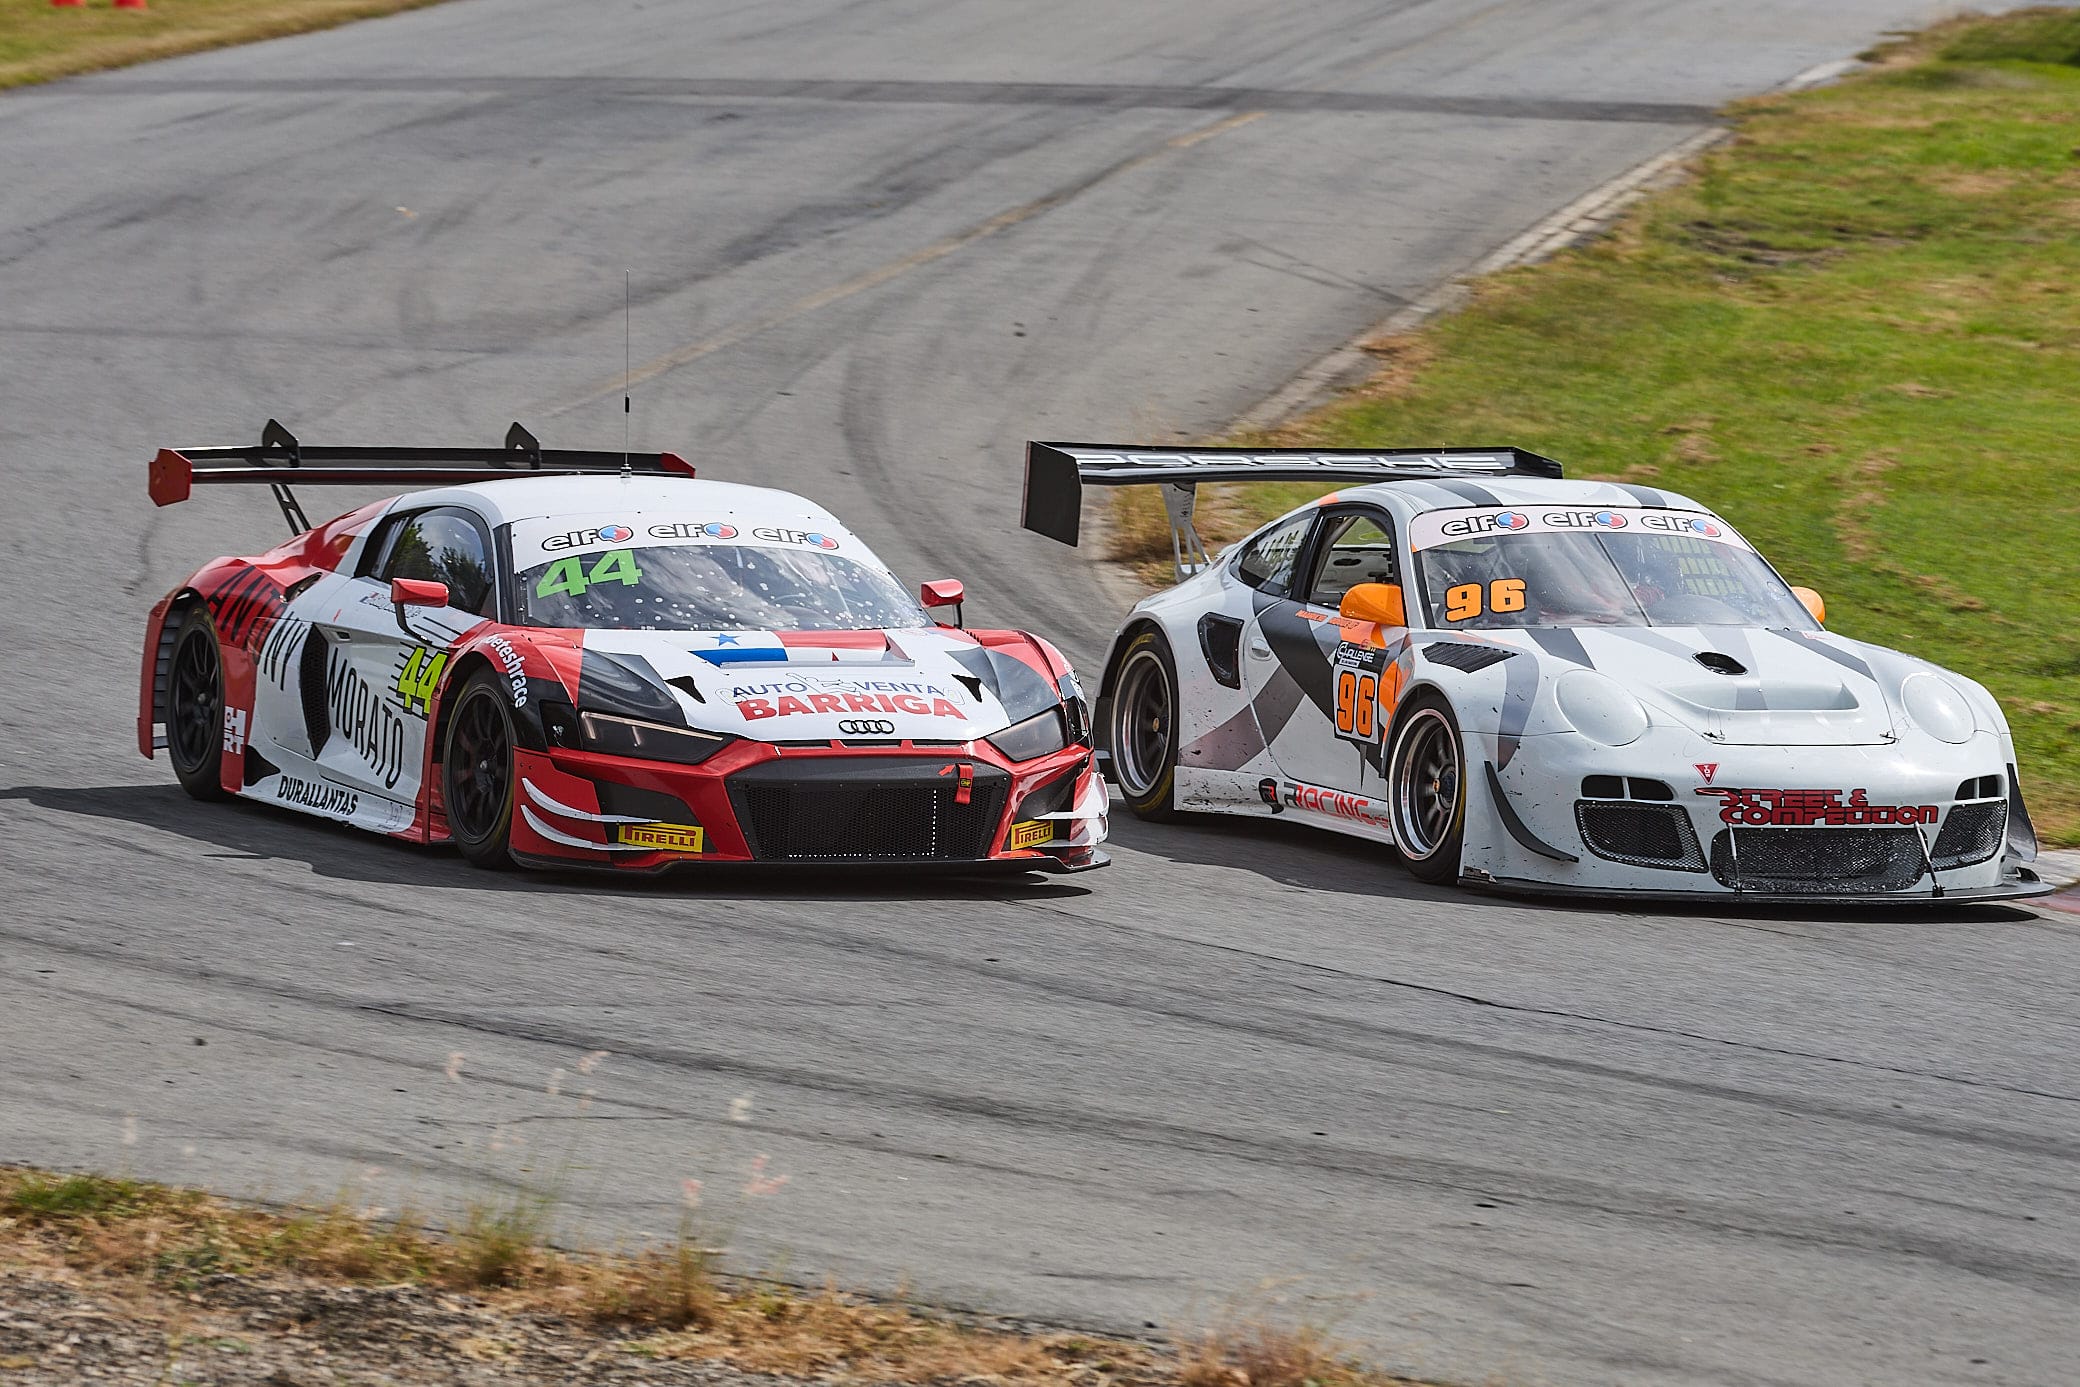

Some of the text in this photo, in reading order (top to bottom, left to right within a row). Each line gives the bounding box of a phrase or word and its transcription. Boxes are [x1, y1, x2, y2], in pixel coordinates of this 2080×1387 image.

[1077, 454, 1507, 470] PORSCHE
[541, 523, 807, 551] elf elf elf
[1441, 511, 1694, 536] elf elf elf
[536, 549, 643, 599] 44
[1445, 578, 1527, 622] 96
[207, 565, 403, 789] ANTONY MORATO
[396, 645, 449, 720] 44
[732, 681, 946, 698] AUTO VENTA
[736, 693, 968, 722] BARRIGA
[1336, 670, 1376, 738] 96
[277, 775, 359, 816] DURALLANTAS
[1849, 788, 1868, 807] &
[625, 824, 697, 847] PIRELLI
[1014, 821, 1051, 845] PIRELLI
